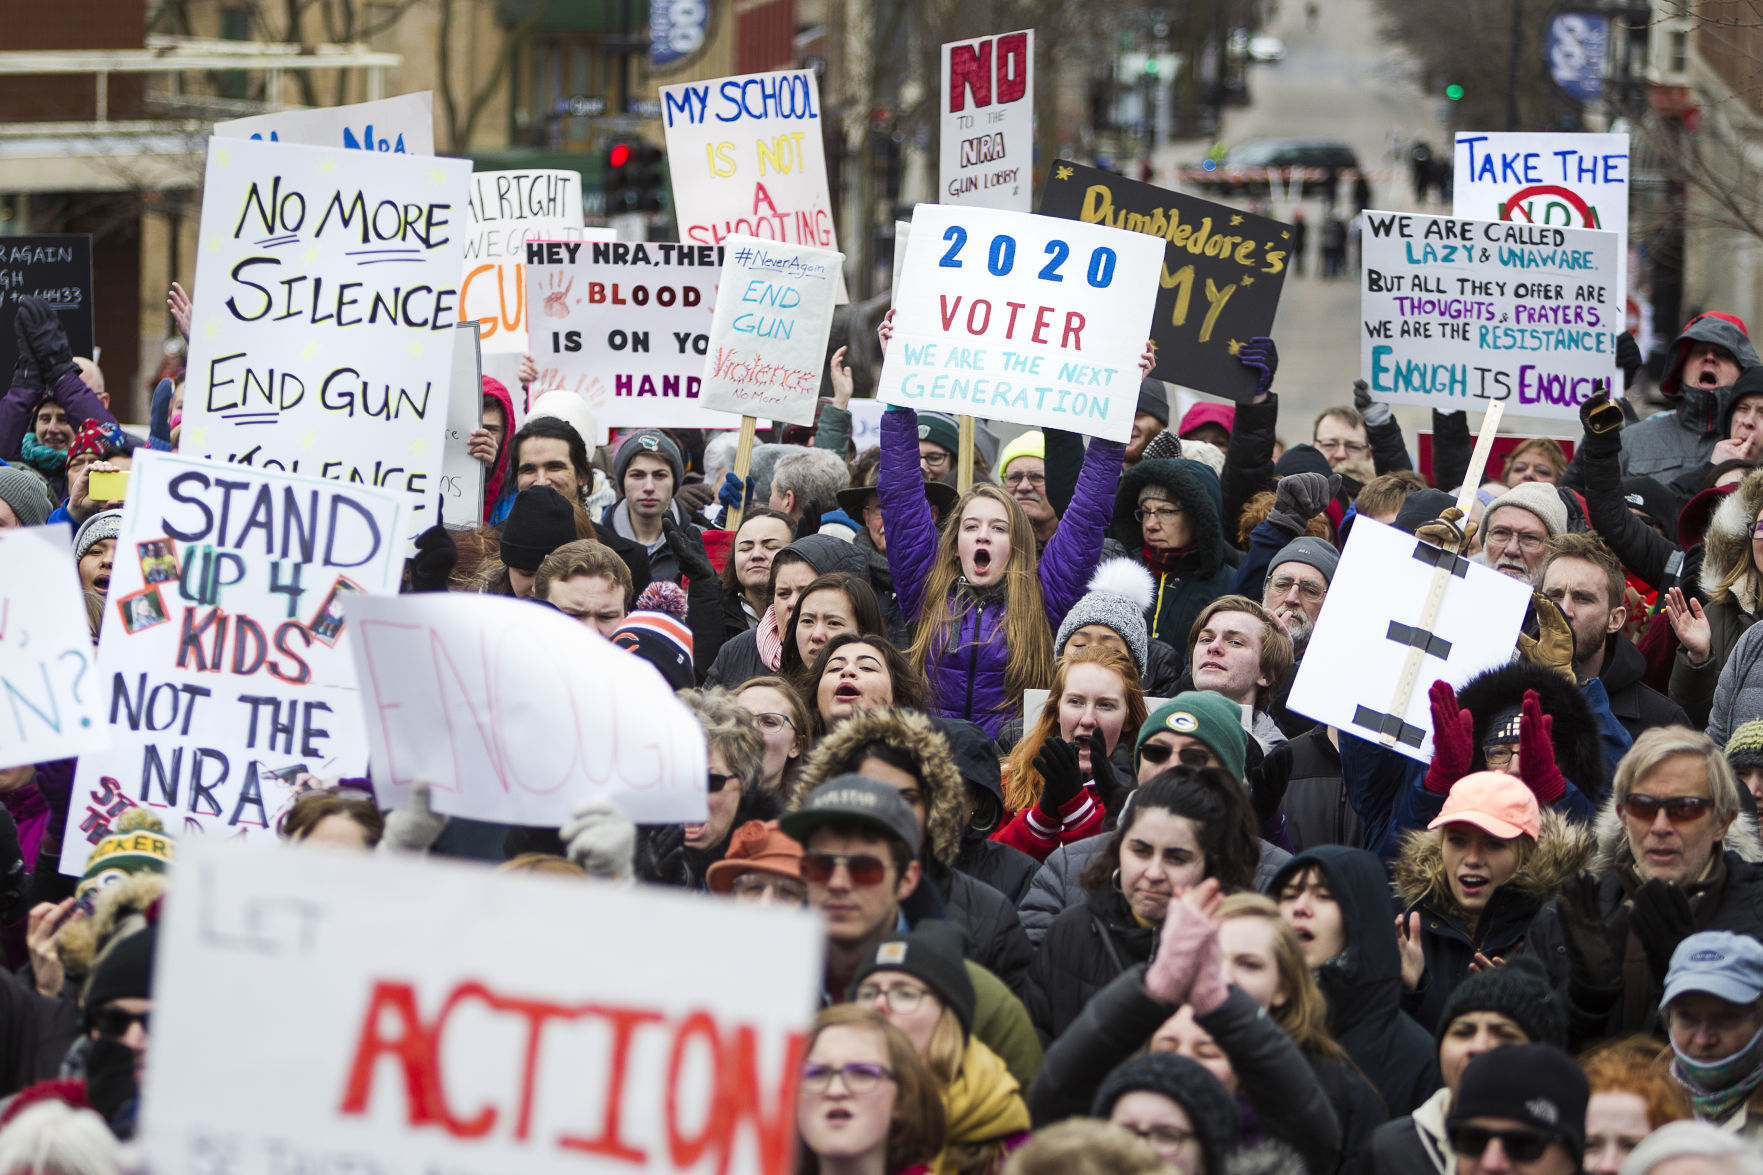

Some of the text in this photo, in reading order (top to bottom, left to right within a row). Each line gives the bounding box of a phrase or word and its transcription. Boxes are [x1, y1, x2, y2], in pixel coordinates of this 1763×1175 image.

[949, 32, 1028, 114] NO
[664, 73, 818, 127] MY SCHOOL
[956, 109, 1007, 130] TO THE
[706, 132, 806, 179] IS NOT
[960, 131, 1006, 168] NRA
[1455, 136, 1629, 185] TAKE THE
[753, 181, 778, 215] A
[948, 167, 1019, 197] GUN LOBBY
[234, 175, 452, 249] NO MORE
[1079, 184, 1288, 275] Dumbledore's
[1368, 214, 1565, 248] WE ARE CALLED
[10, 245, 73, 265] AGAIN
[526, 242, 582, 265] HEY
[734, 248, 826, 279] #NeverAgain
[938, 225, 1118, 289] 2020
[1405, 240, 1599, 271] LAZY & UNAWARE.
[225, 256, 458, 330] SILENCE
[588, 281, 701, 307] BLOOD
[742, 280, 801, 308] END
[1367, 268, 1607, 304] BUT ALL THEY OFFER ARE
[732, 313, 795, 340] GUN
[939, 293, 1087, 352] VOTER
[1392, 296, 1496, 322] THOUGHTS
[1514, 304, 1606, 328] PRAYERS.
[552, 329, 709, 355] IS ON YO
[1365, 319, 1615, 354] WE ARE THE RESISTANCE!
[206, 352, 432, 421] END GUN
[615, 374, 702, 398] HAND
[904, 343, 1119, 387] WE ARE THE NEXT
[1371, 345, 1468, 398] ENOUGH
[1473, 366, 1512, 401] IS
[732, 388, 787, 404] No More!
[901, 372, 1111, 421] GENERATION
[162, 471, 382, 567] STAND
[178, 545, 309, 618] UP 4
[175, 606, 314, 686] KIDS
[109, 671, 335, 760] NOT THE
[139, 743, 270, 830] NRA
[337, 976, 804, 1175] ACTION
